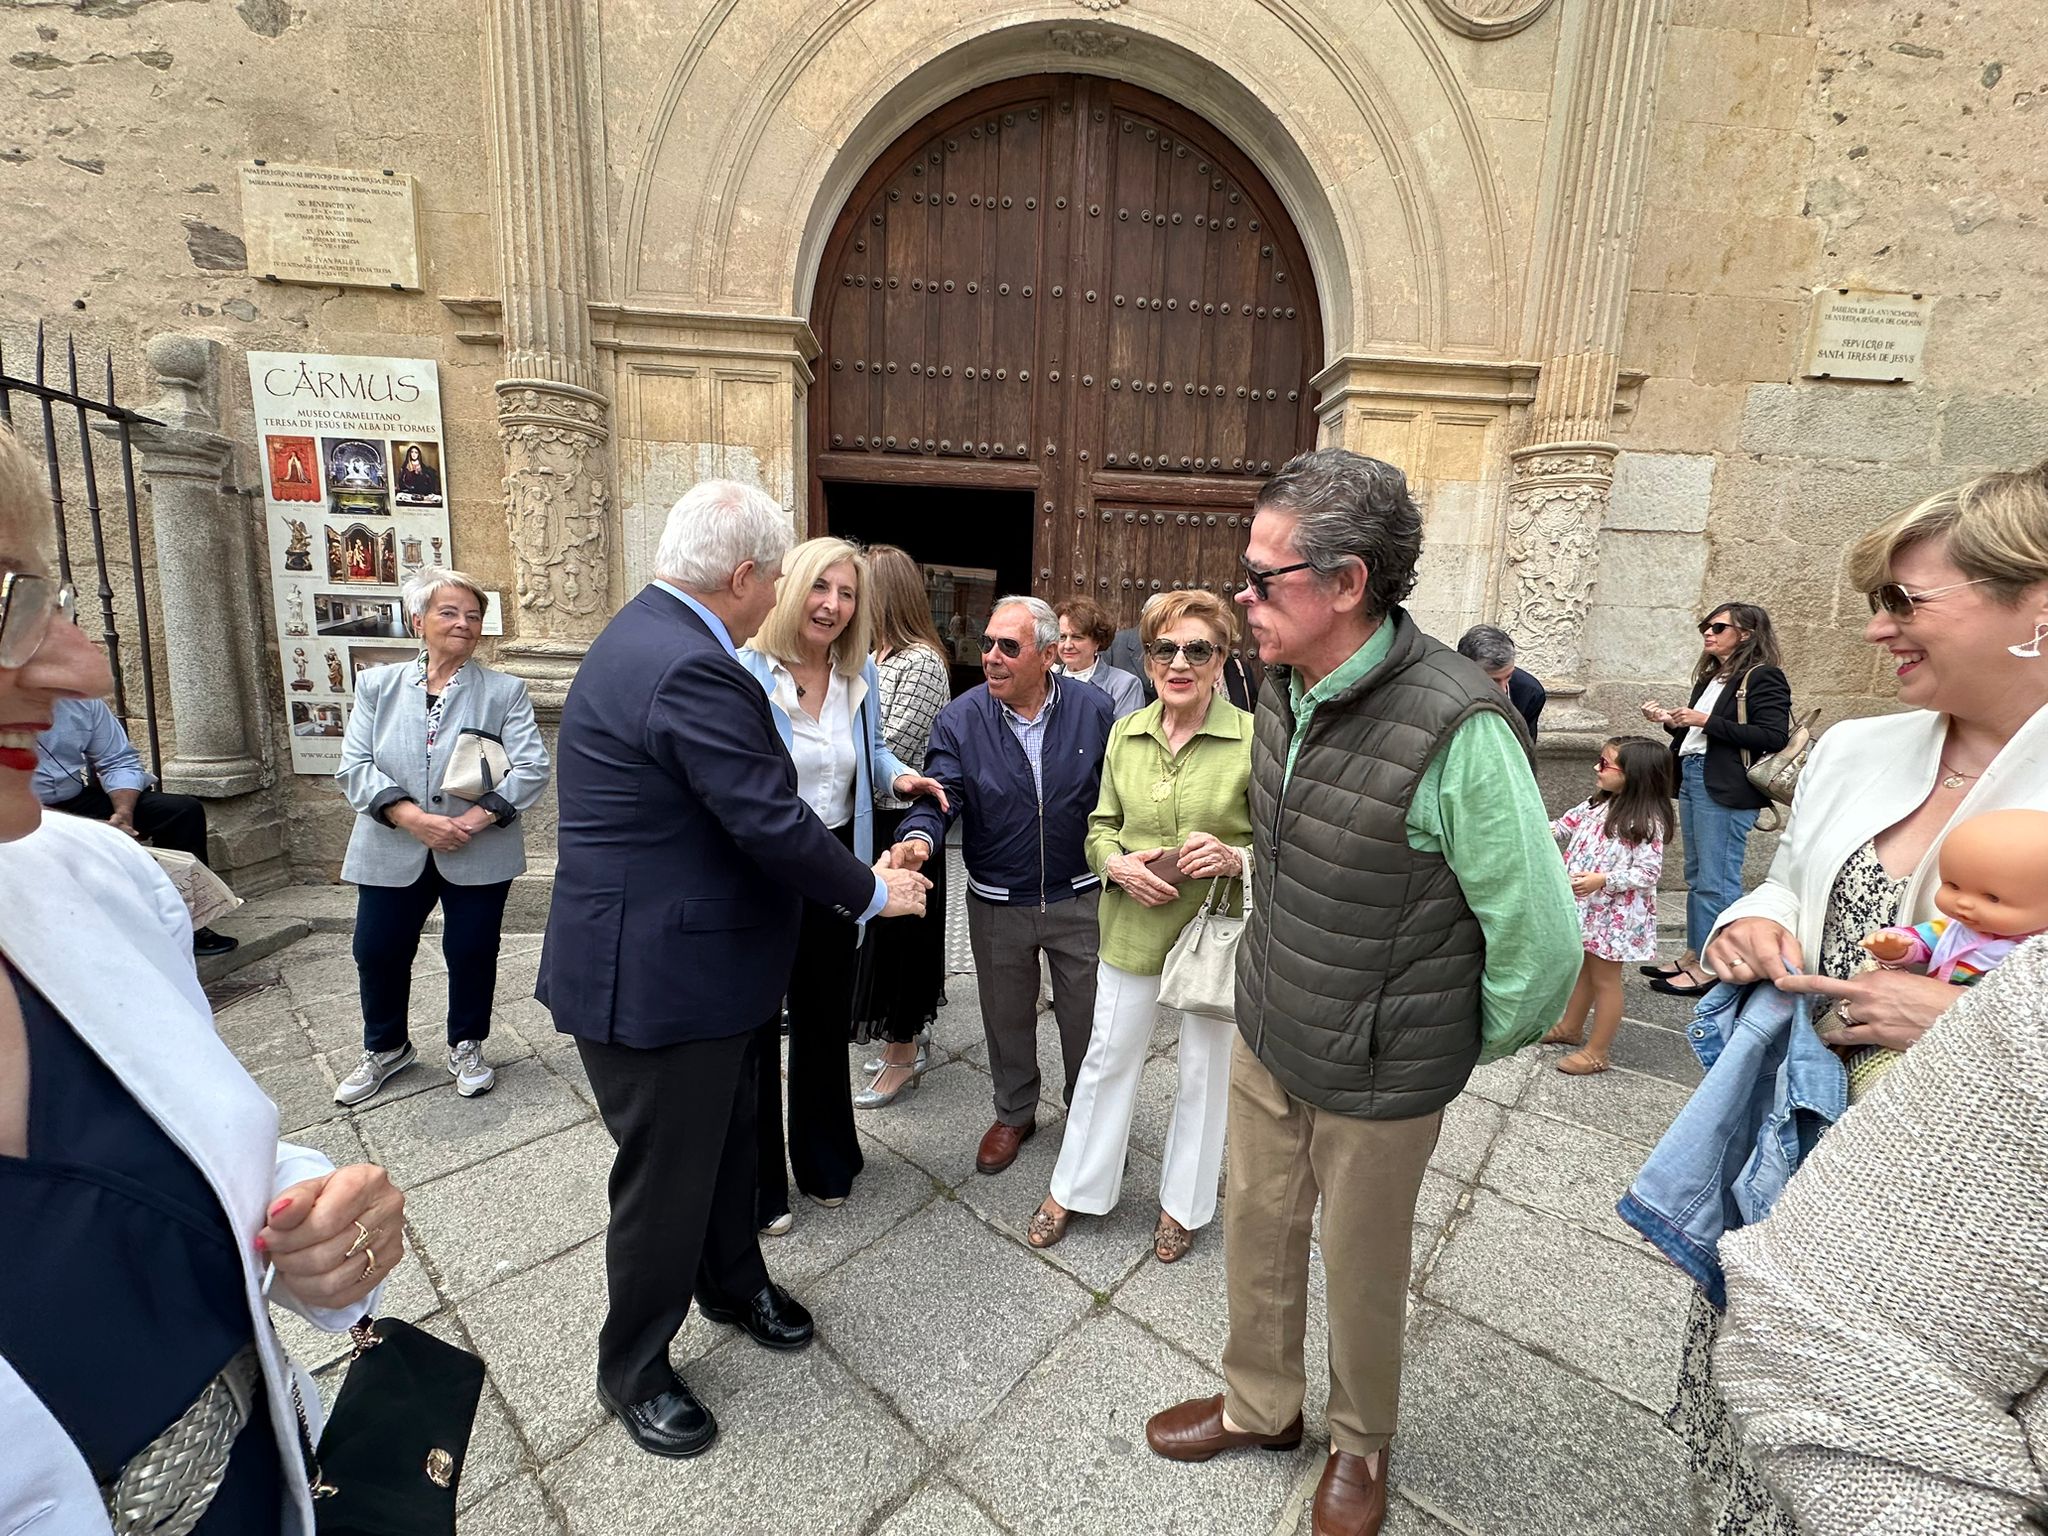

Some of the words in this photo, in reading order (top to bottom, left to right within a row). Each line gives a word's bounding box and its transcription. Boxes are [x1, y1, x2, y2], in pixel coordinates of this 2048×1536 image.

[1817, 349, 1845, 360] SANTA
[1847, 350, 1877, 363] TERESA
[1889, 354, 1915, 364] JESVS
[297, 409, 331, 419] MUSEO
[332, 411, 401, 422] CARMELITANO
[264, 418, 299, 428] TERESA
[300, 419, 313, 428] DE
[315, 418, 342, 430] JESÚS
[343, 421, 356, 430] EN
[358, 422, 381, 431] ALBA
[383, 423, 396, 432] DE
[397, 424, 436, 434] TORMES
